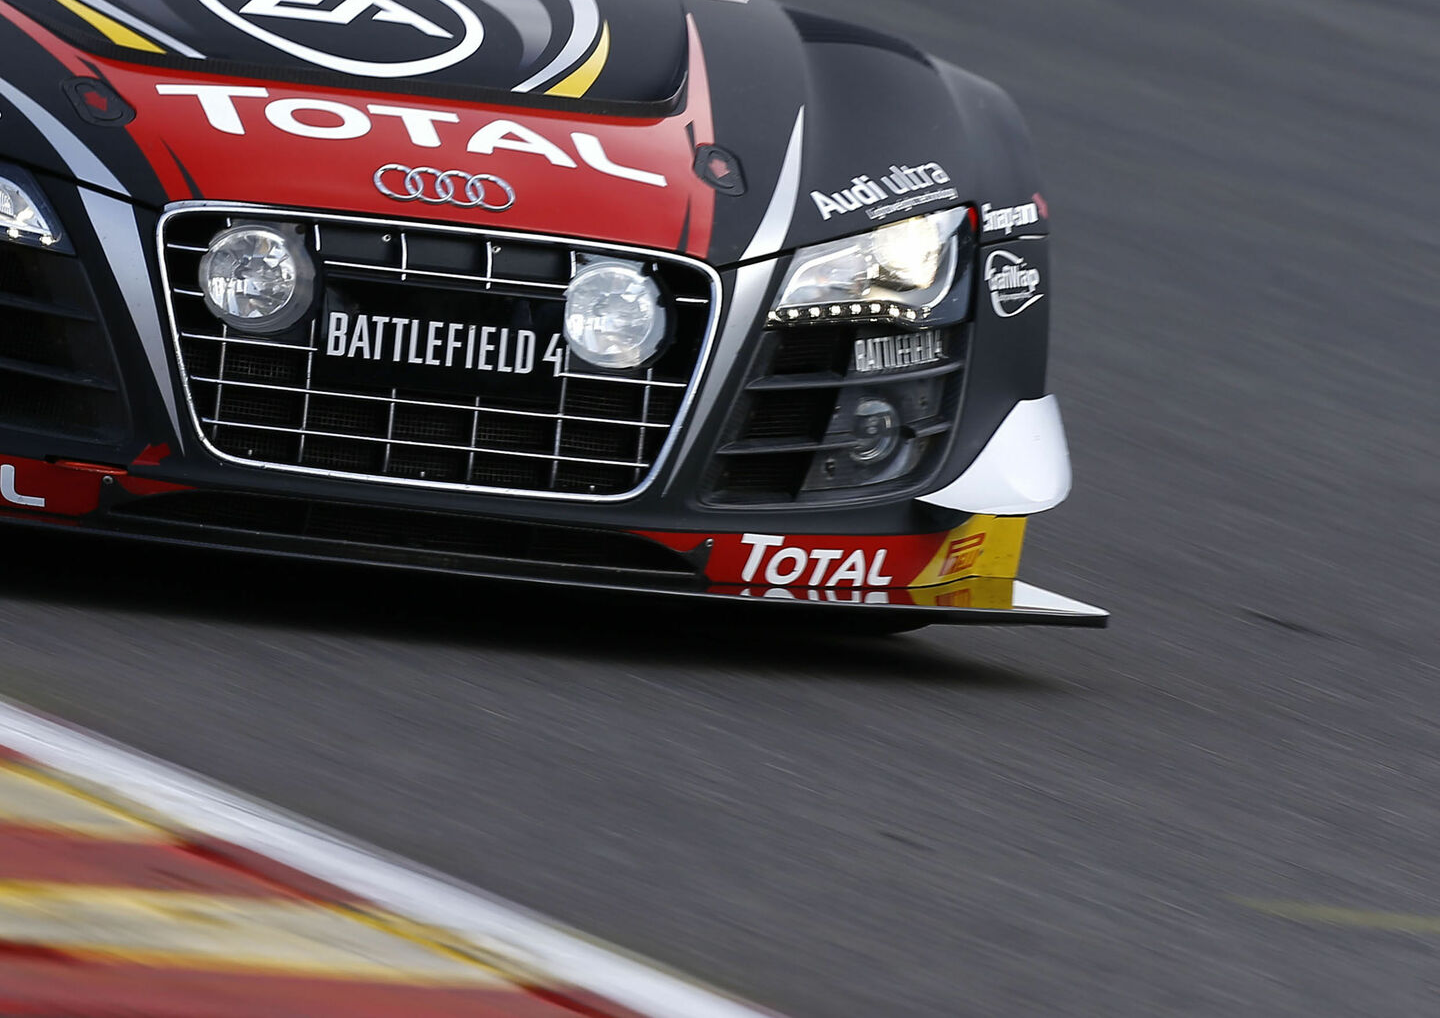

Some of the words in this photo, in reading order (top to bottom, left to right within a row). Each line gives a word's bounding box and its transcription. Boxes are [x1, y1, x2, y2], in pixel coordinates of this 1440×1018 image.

[155, 83, 667, 188] TOTAL
[810, 174, 889, 221] Audi
[880, 162, 951, 195] ultra
[325, 310, 536, 375] BATTLEFIELD
[542, 333, 563, 377] 4
[739, 533, 893, 587] TOTAL
